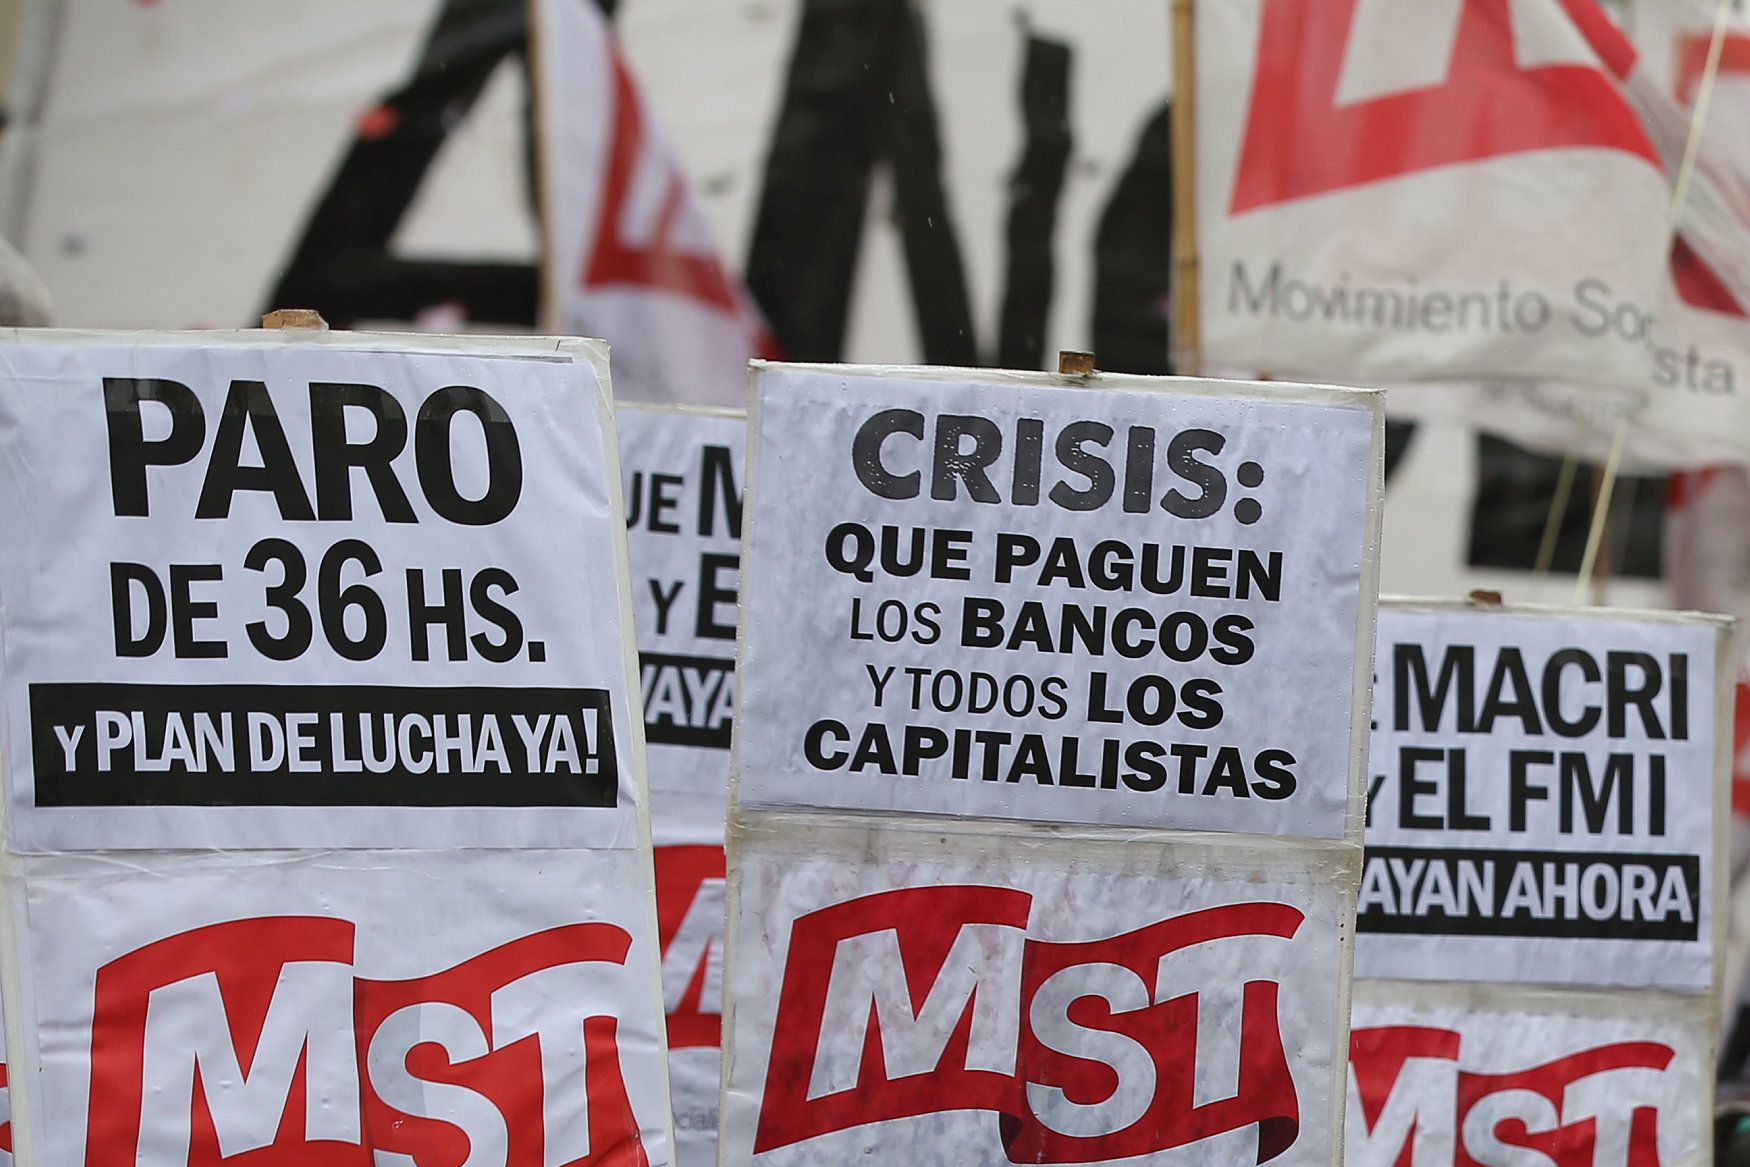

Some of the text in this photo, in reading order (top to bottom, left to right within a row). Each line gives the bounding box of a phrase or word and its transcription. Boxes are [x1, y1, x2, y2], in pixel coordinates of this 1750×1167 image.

[1227, 260, 1552, 336] Movimiento
[102, 377, 523, 526] PARO
[852, 407, 1266, 526] CRISIS:
[110, 538, 546, 663] DE 36 HS.
[824, 521, 1284, 602] QUE PAGUEN
[648, 579, 685, 636] Y
[849, 596, 1256, 666] LOS BANCOS
[864, 664, 1225, 731] Y TODOS LOS
[1393, 642, 1689, 741] MACRI
[54, 708, 599, 776] Y PLAN DE LUCHA YA!
[803, 718, 1299, 801] CAPITALISTAS
[1398, 746, 1491, 831] EL
[1509, 749, 1666, 836] FMI
[1357, 856, 1694, 923] AYAN AHORA
[806, 922, 1293, 1138] MST
